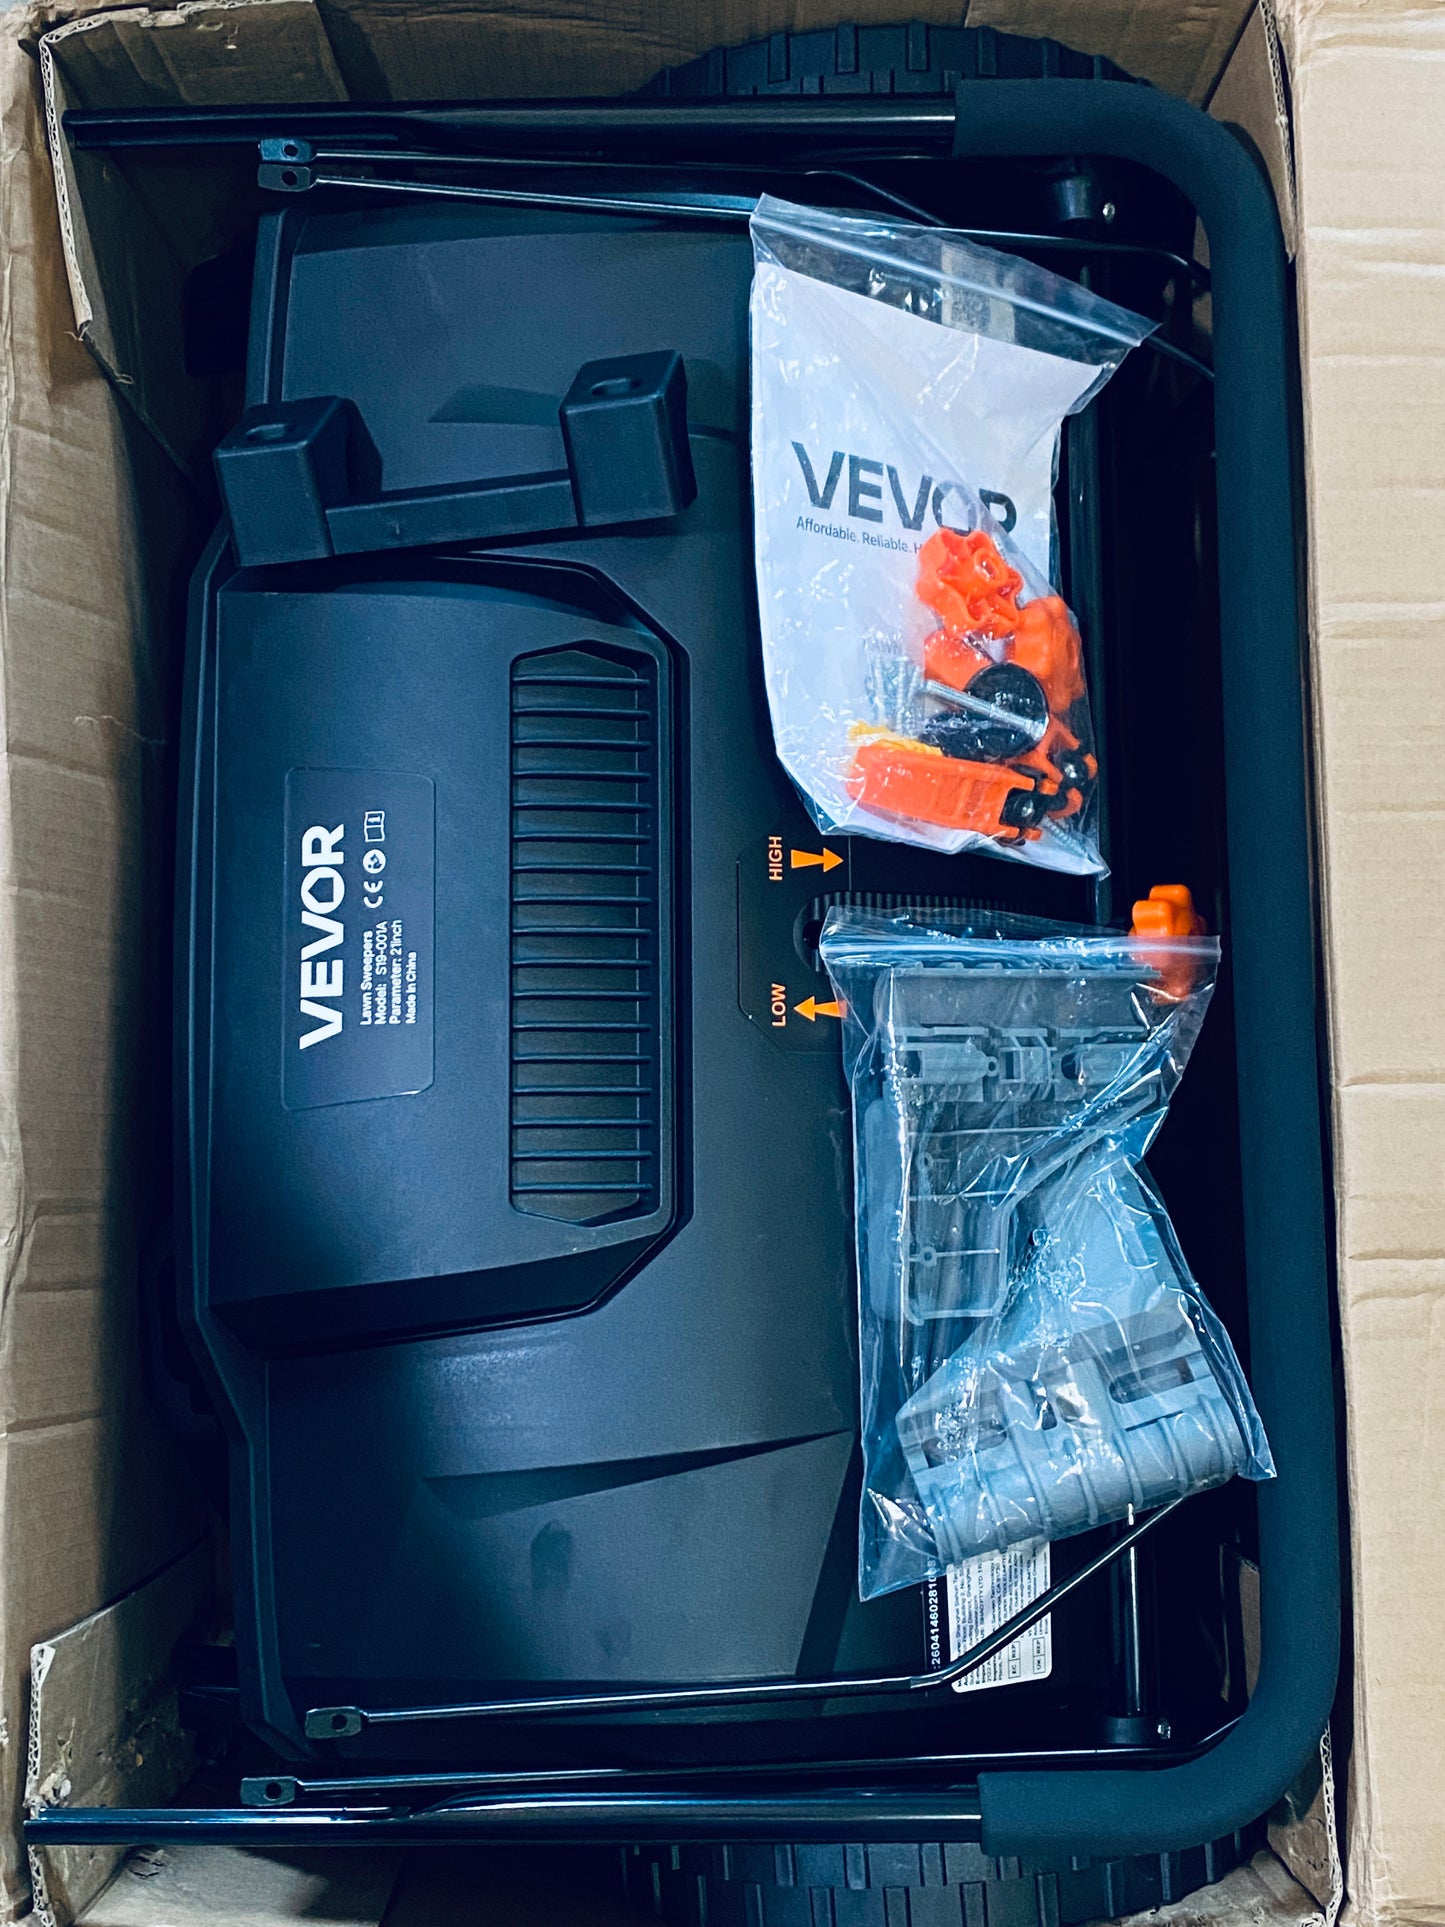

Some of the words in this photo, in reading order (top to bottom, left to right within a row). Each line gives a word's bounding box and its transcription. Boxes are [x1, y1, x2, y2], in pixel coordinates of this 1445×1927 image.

[796, 516, 860, 543] Affordable.
[862, 532, 915, 553] Reliable.
[768, 836, 783, 881] HIGH
[299, 823, 345, 1050] VEVOR
[375, 921, 388, 975] S19-001A
[390, 920, 403, 955] 21inch
[361, 930, 375, 990] Sweepers
[405, 952, 417, 982] China
[360, 992, 372, 1025] Lawn
[374, 983, 387, 1025] Model:
[389, 958, 402, 1024] Parameter:
[405, 994, 417, 1024] Made
[771, 983, 786, 1027] LOW
[1011, 1664, 1017, 1674] EC
[1036, 1659, 1041, 1670] UK
